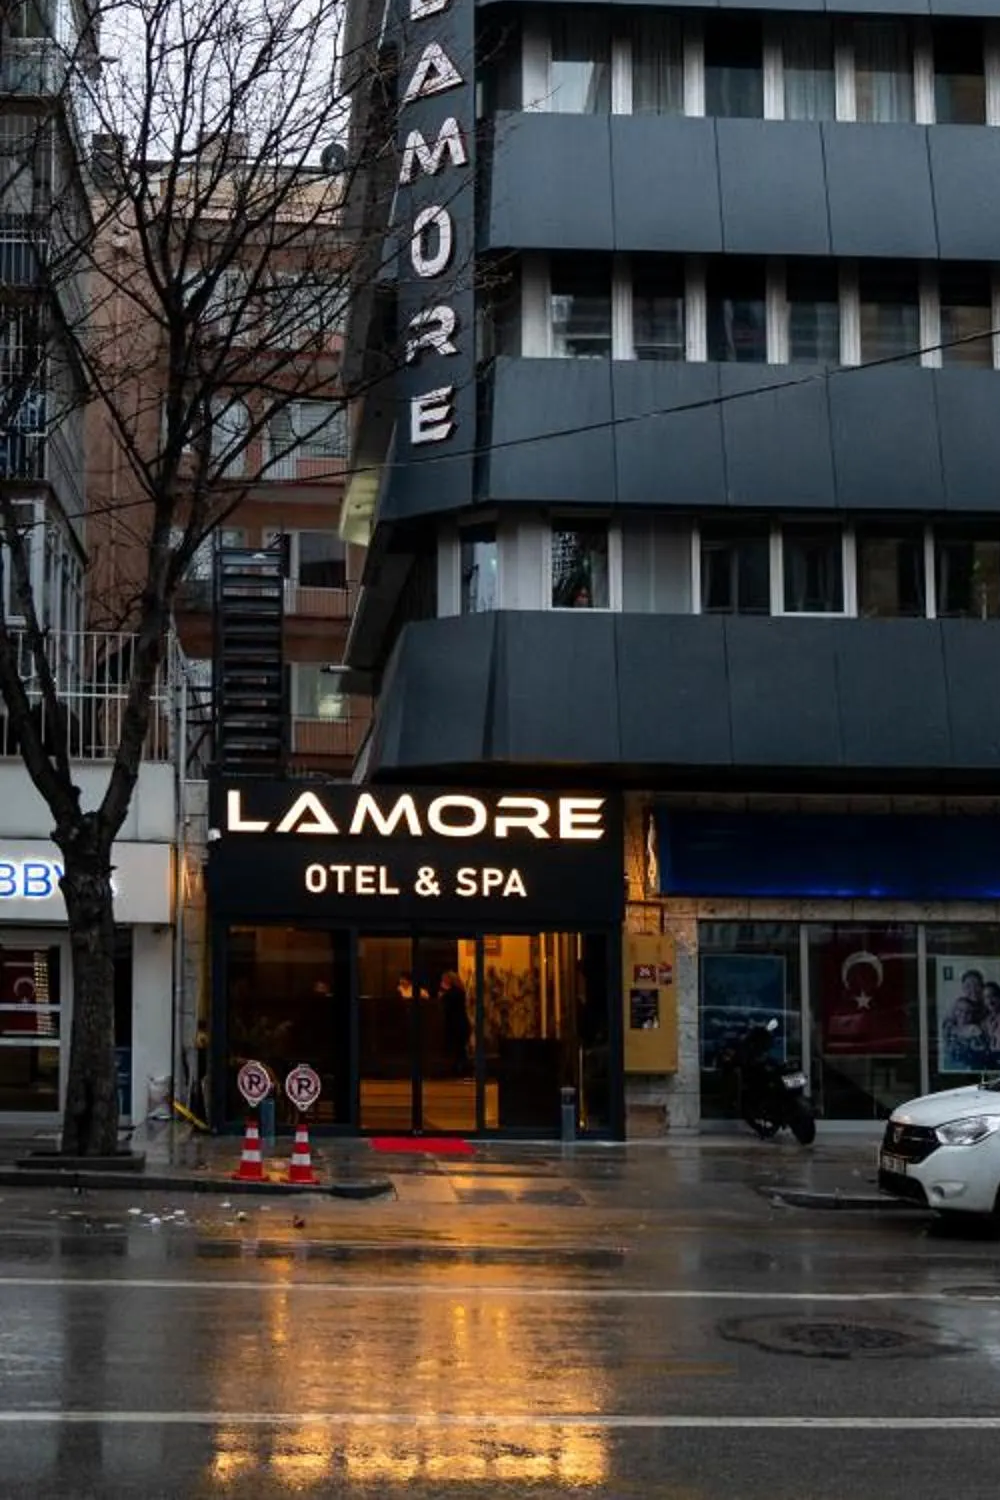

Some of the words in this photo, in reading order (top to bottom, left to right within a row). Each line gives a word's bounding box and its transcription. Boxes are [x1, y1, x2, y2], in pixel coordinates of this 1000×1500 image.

[227, 789, 607, 840] LAMORE
[0, 863, 65, 897] BB
[305, 863, 400, 895] OTEL
[415, 866, 441, 897] &
[456, 868, 527, 898] SPA
